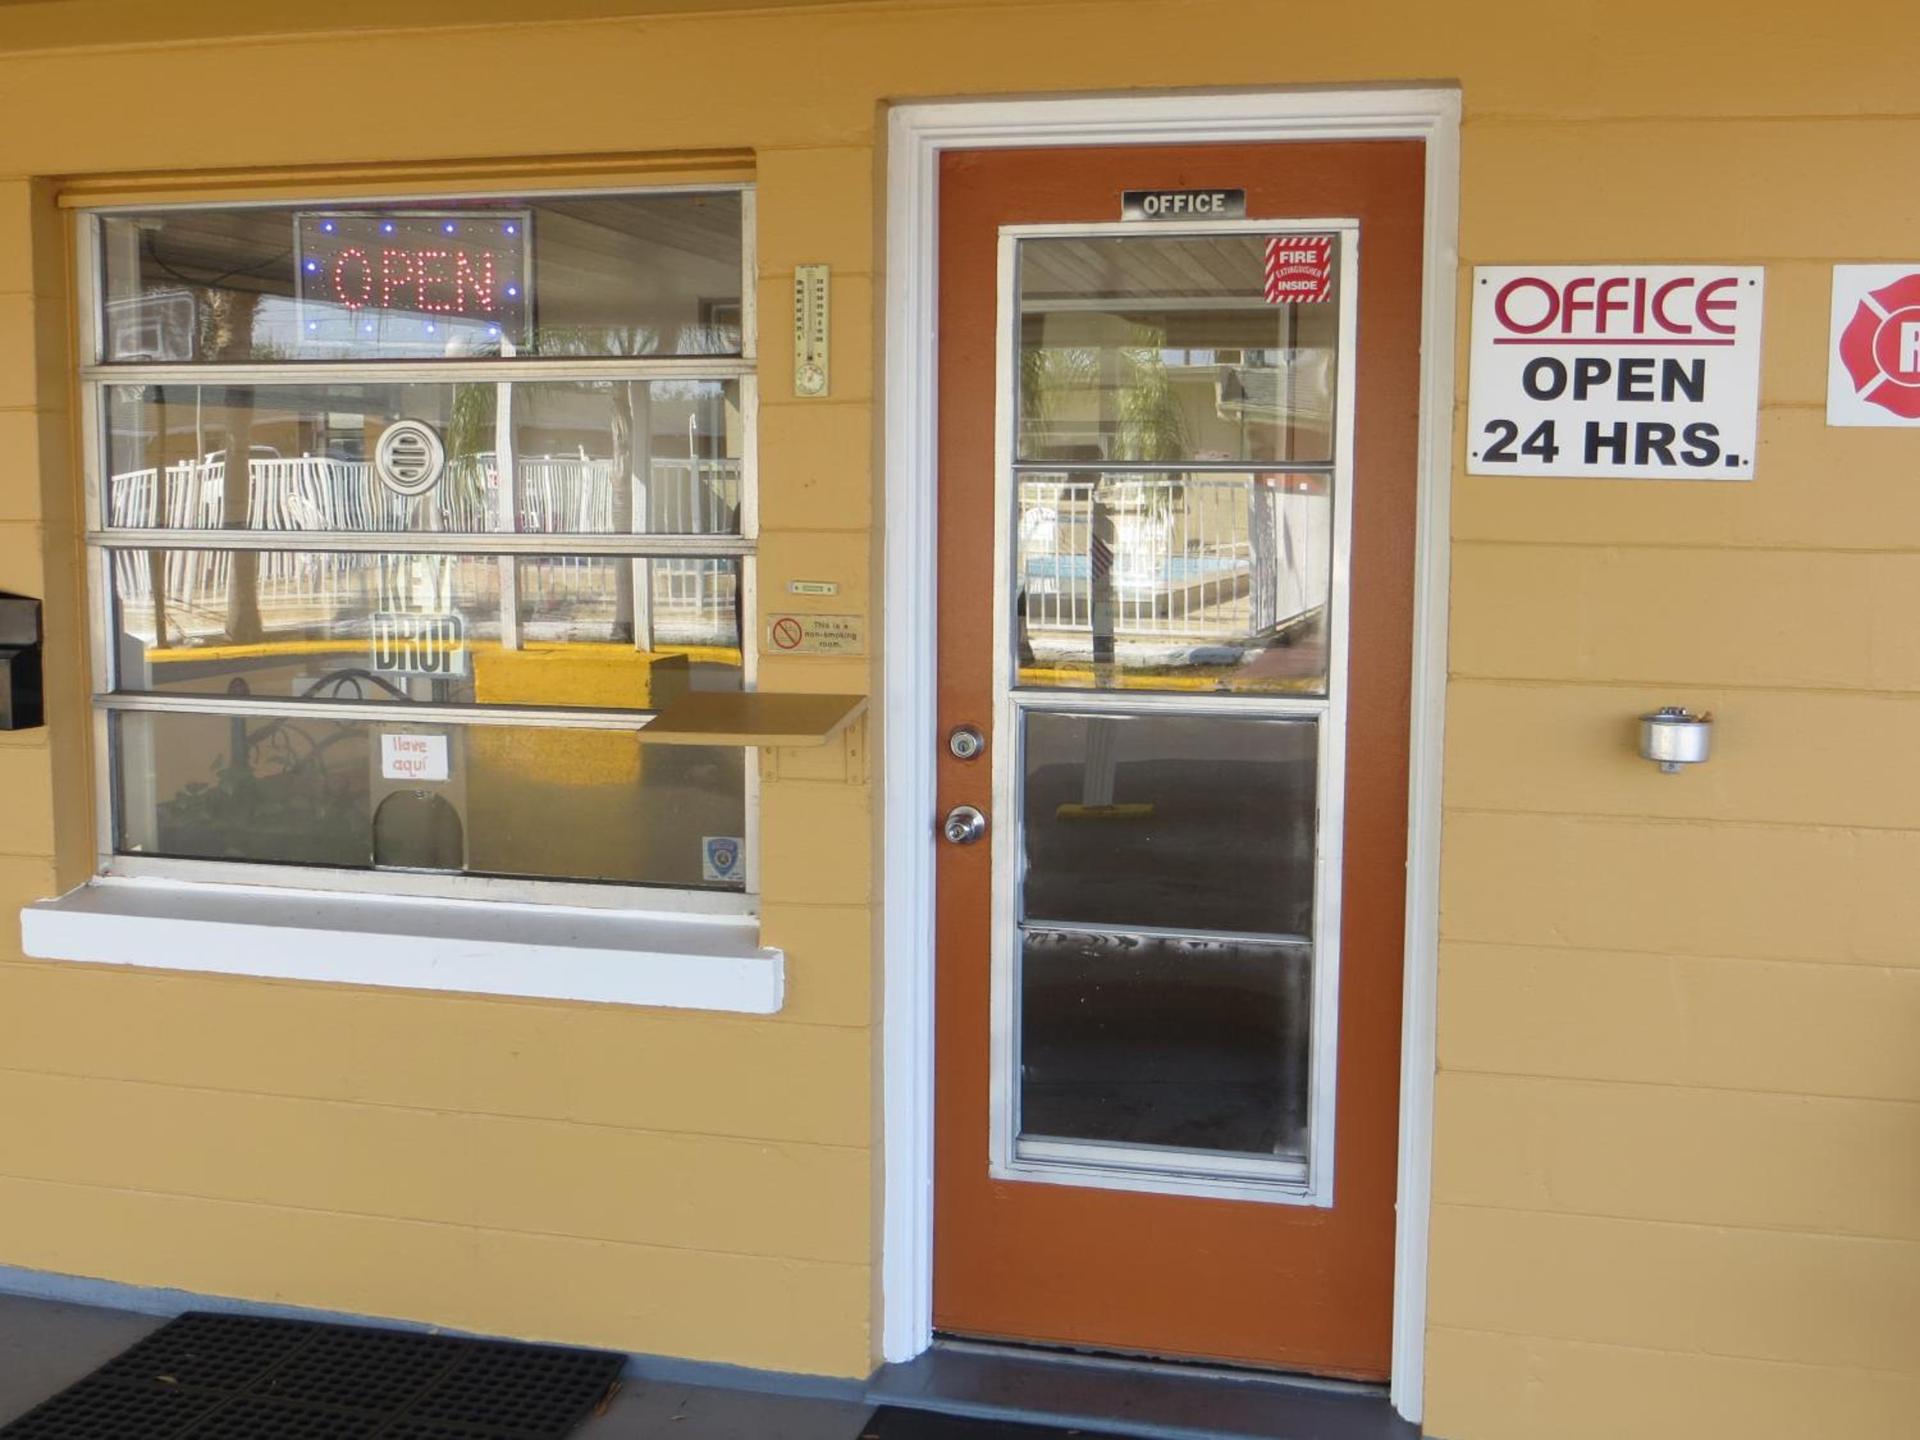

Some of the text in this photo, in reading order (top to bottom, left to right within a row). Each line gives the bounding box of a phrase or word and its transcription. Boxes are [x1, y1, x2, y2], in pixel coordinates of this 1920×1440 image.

[1143, 193, 1225, 214] OFFICE
[1279, 250, 1317, 264] FIRE
[333, 246, 496, 312] OPEN
[1278, 280, 1318, 291] INSIDE
[1494, 277, 1738, 334] OFFICE
[1522, 356, 1706, 402] OPEN
[1482, 419, 1740, 467] 24 HRS.
[380, 553, 448, 614] KEY
[804, 631, 857, 640] non-smoking
[814, 621, 830, 630] This
[374, 614, 463, 673] DROP
[393, 736, 427, 752] llave
